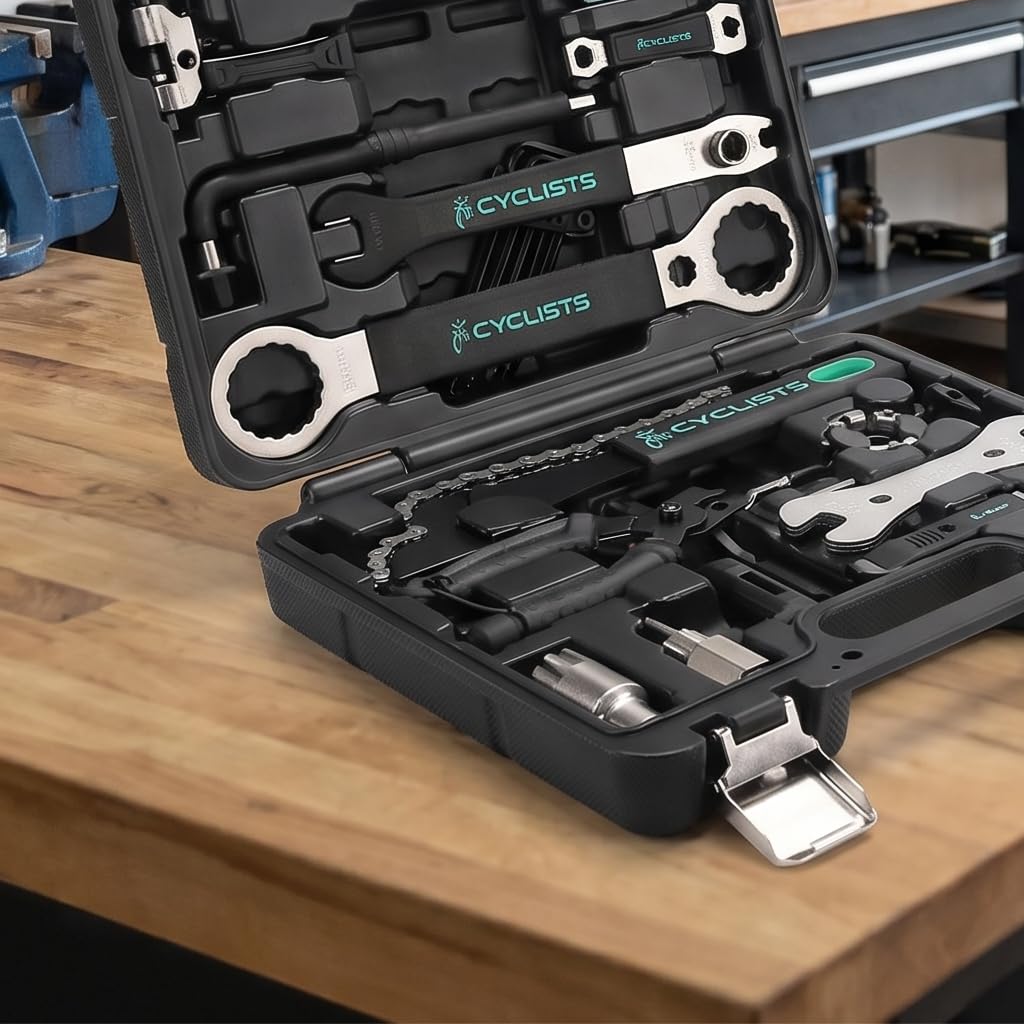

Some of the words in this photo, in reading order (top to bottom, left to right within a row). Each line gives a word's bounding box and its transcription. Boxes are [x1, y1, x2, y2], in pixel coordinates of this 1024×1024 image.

[476, 172, 597, 215] CYCLISTS
[472, 293, 591, 339] CYCLISTS
[671, 380, 809, 433] CYCLISTS
